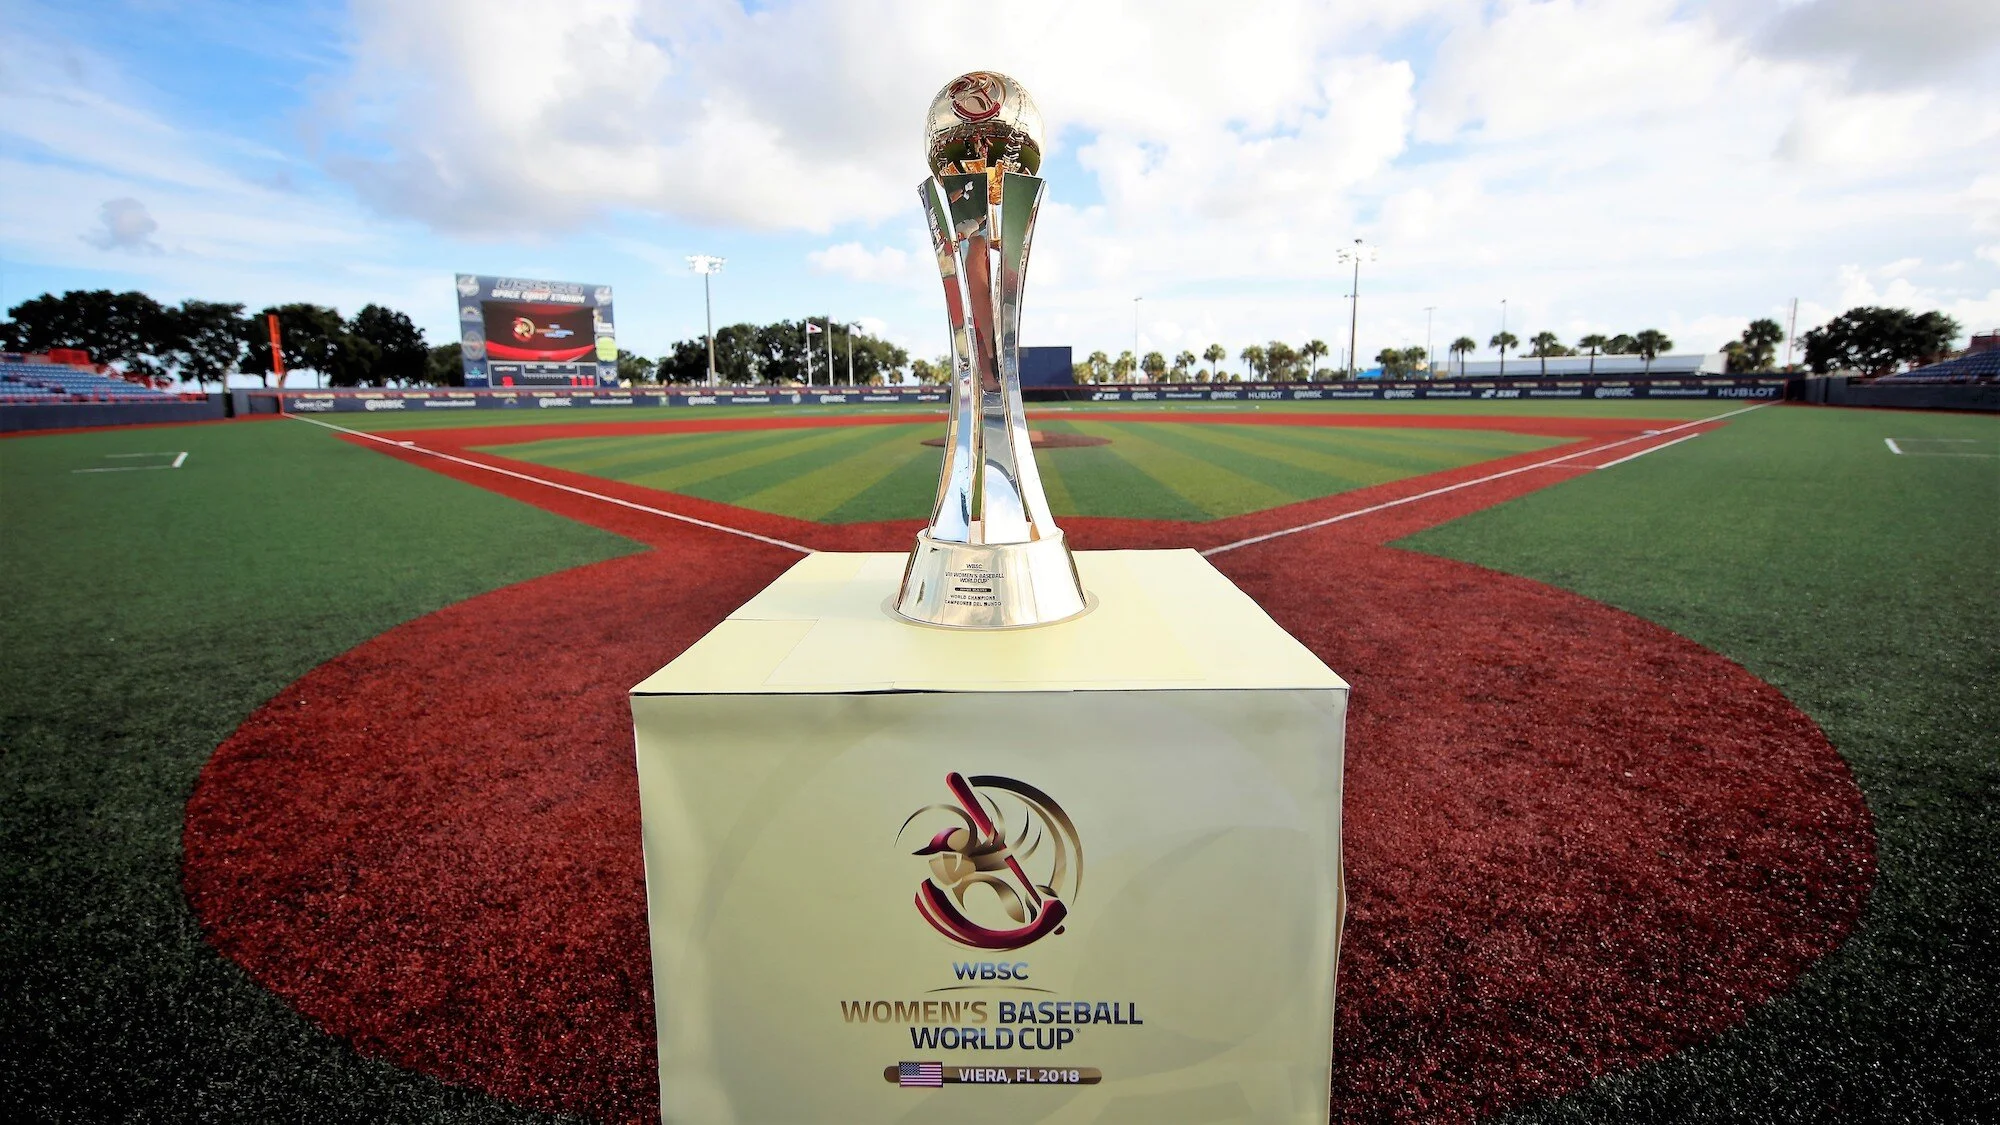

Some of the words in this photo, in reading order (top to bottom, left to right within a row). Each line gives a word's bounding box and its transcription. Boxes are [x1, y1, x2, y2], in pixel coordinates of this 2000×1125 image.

[491, 289, 520, 300] SPACE
[1248, 391, 1282, 399] HUBLOT
[1718, 388, 1776, 397] HUBLOT
[952, 961, 1029, 981] WBSC
[840, 1000, 988, 1024] WOMEN'S
[999, 1001, 1144, 1025] BASEBALL
[910, 1027, 1014, 1050] WORLD
[958, 1068, 1012, 1084] VIERA,
[1017, 1069, 1036, 1082] FL
[1038, 1069, 1080, 1083] 2018
